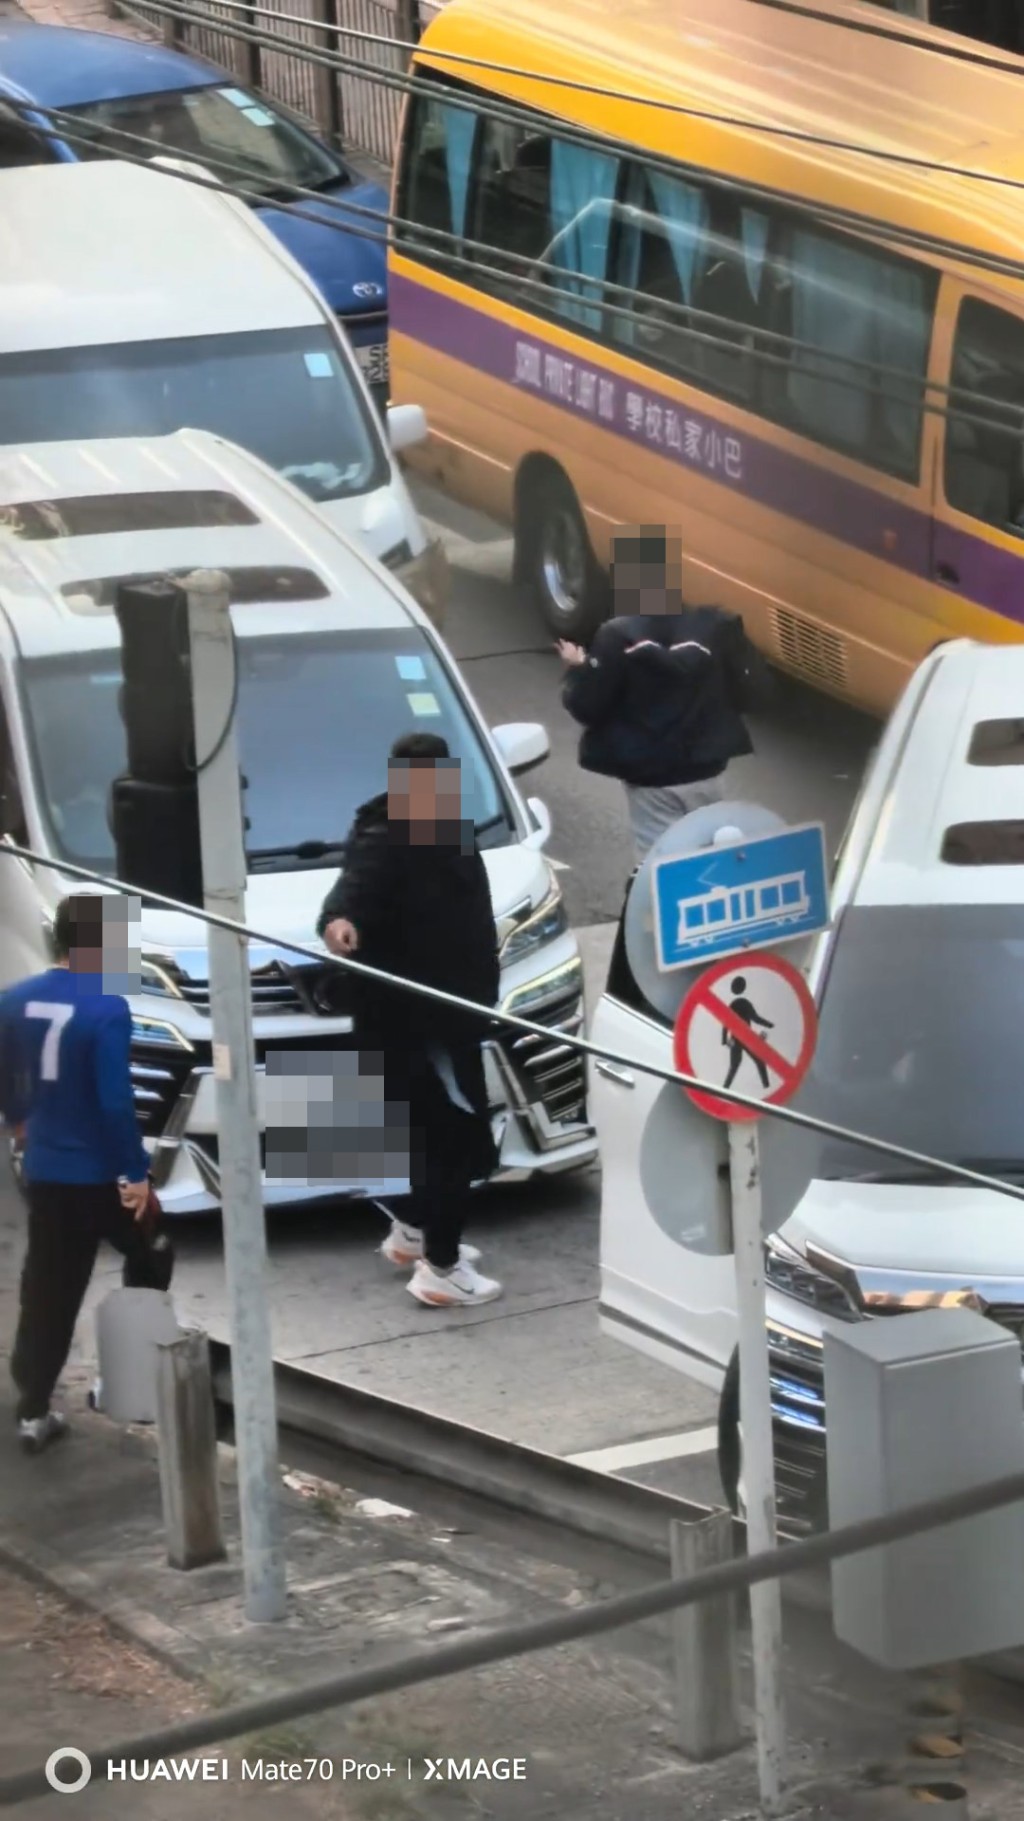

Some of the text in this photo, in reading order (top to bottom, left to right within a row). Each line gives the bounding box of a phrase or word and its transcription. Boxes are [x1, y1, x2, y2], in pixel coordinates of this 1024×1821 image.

[626, 391, 742, 478] 學校私家小巴
[25, 1001, 75, 1081] 7
